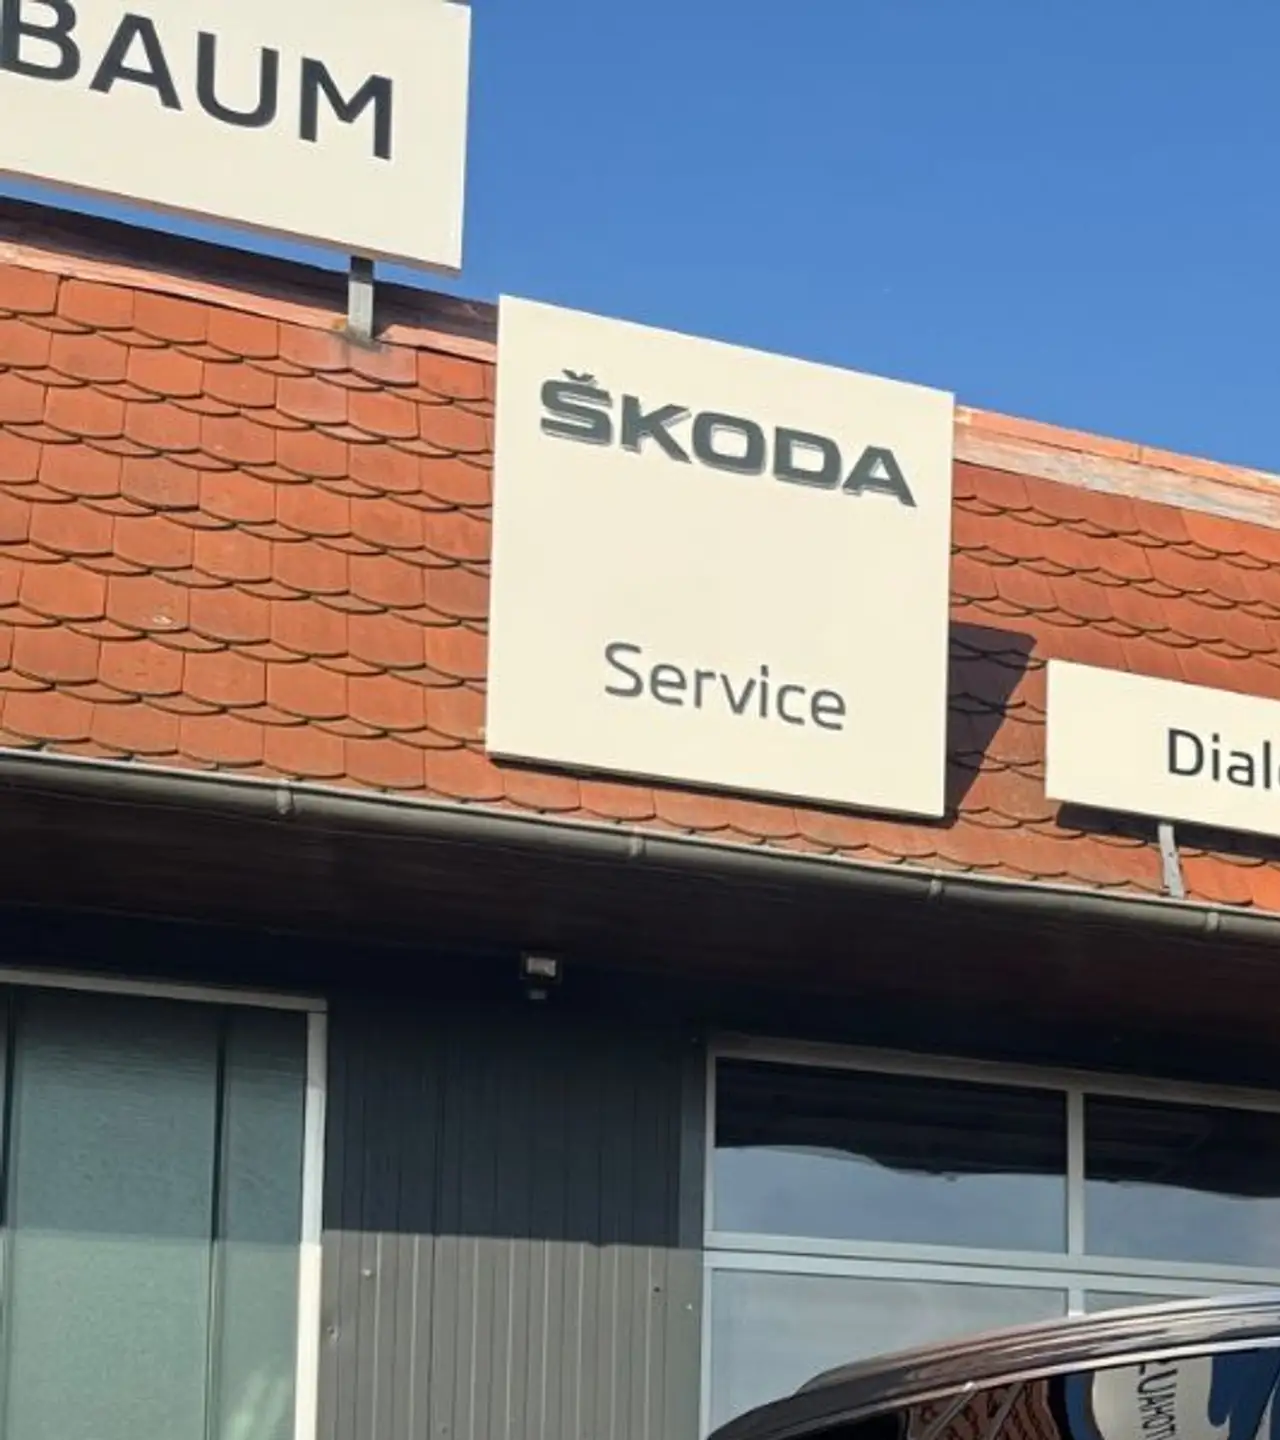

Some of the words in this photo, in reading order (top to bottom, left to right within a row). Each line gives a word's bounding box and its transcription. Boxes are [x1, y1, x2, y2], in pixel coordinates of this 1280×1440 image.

[0, 0, 393, 160] BAUM
[540, 369, 917, 507] ŠKODA
[603, 641, 847, 731] Service
